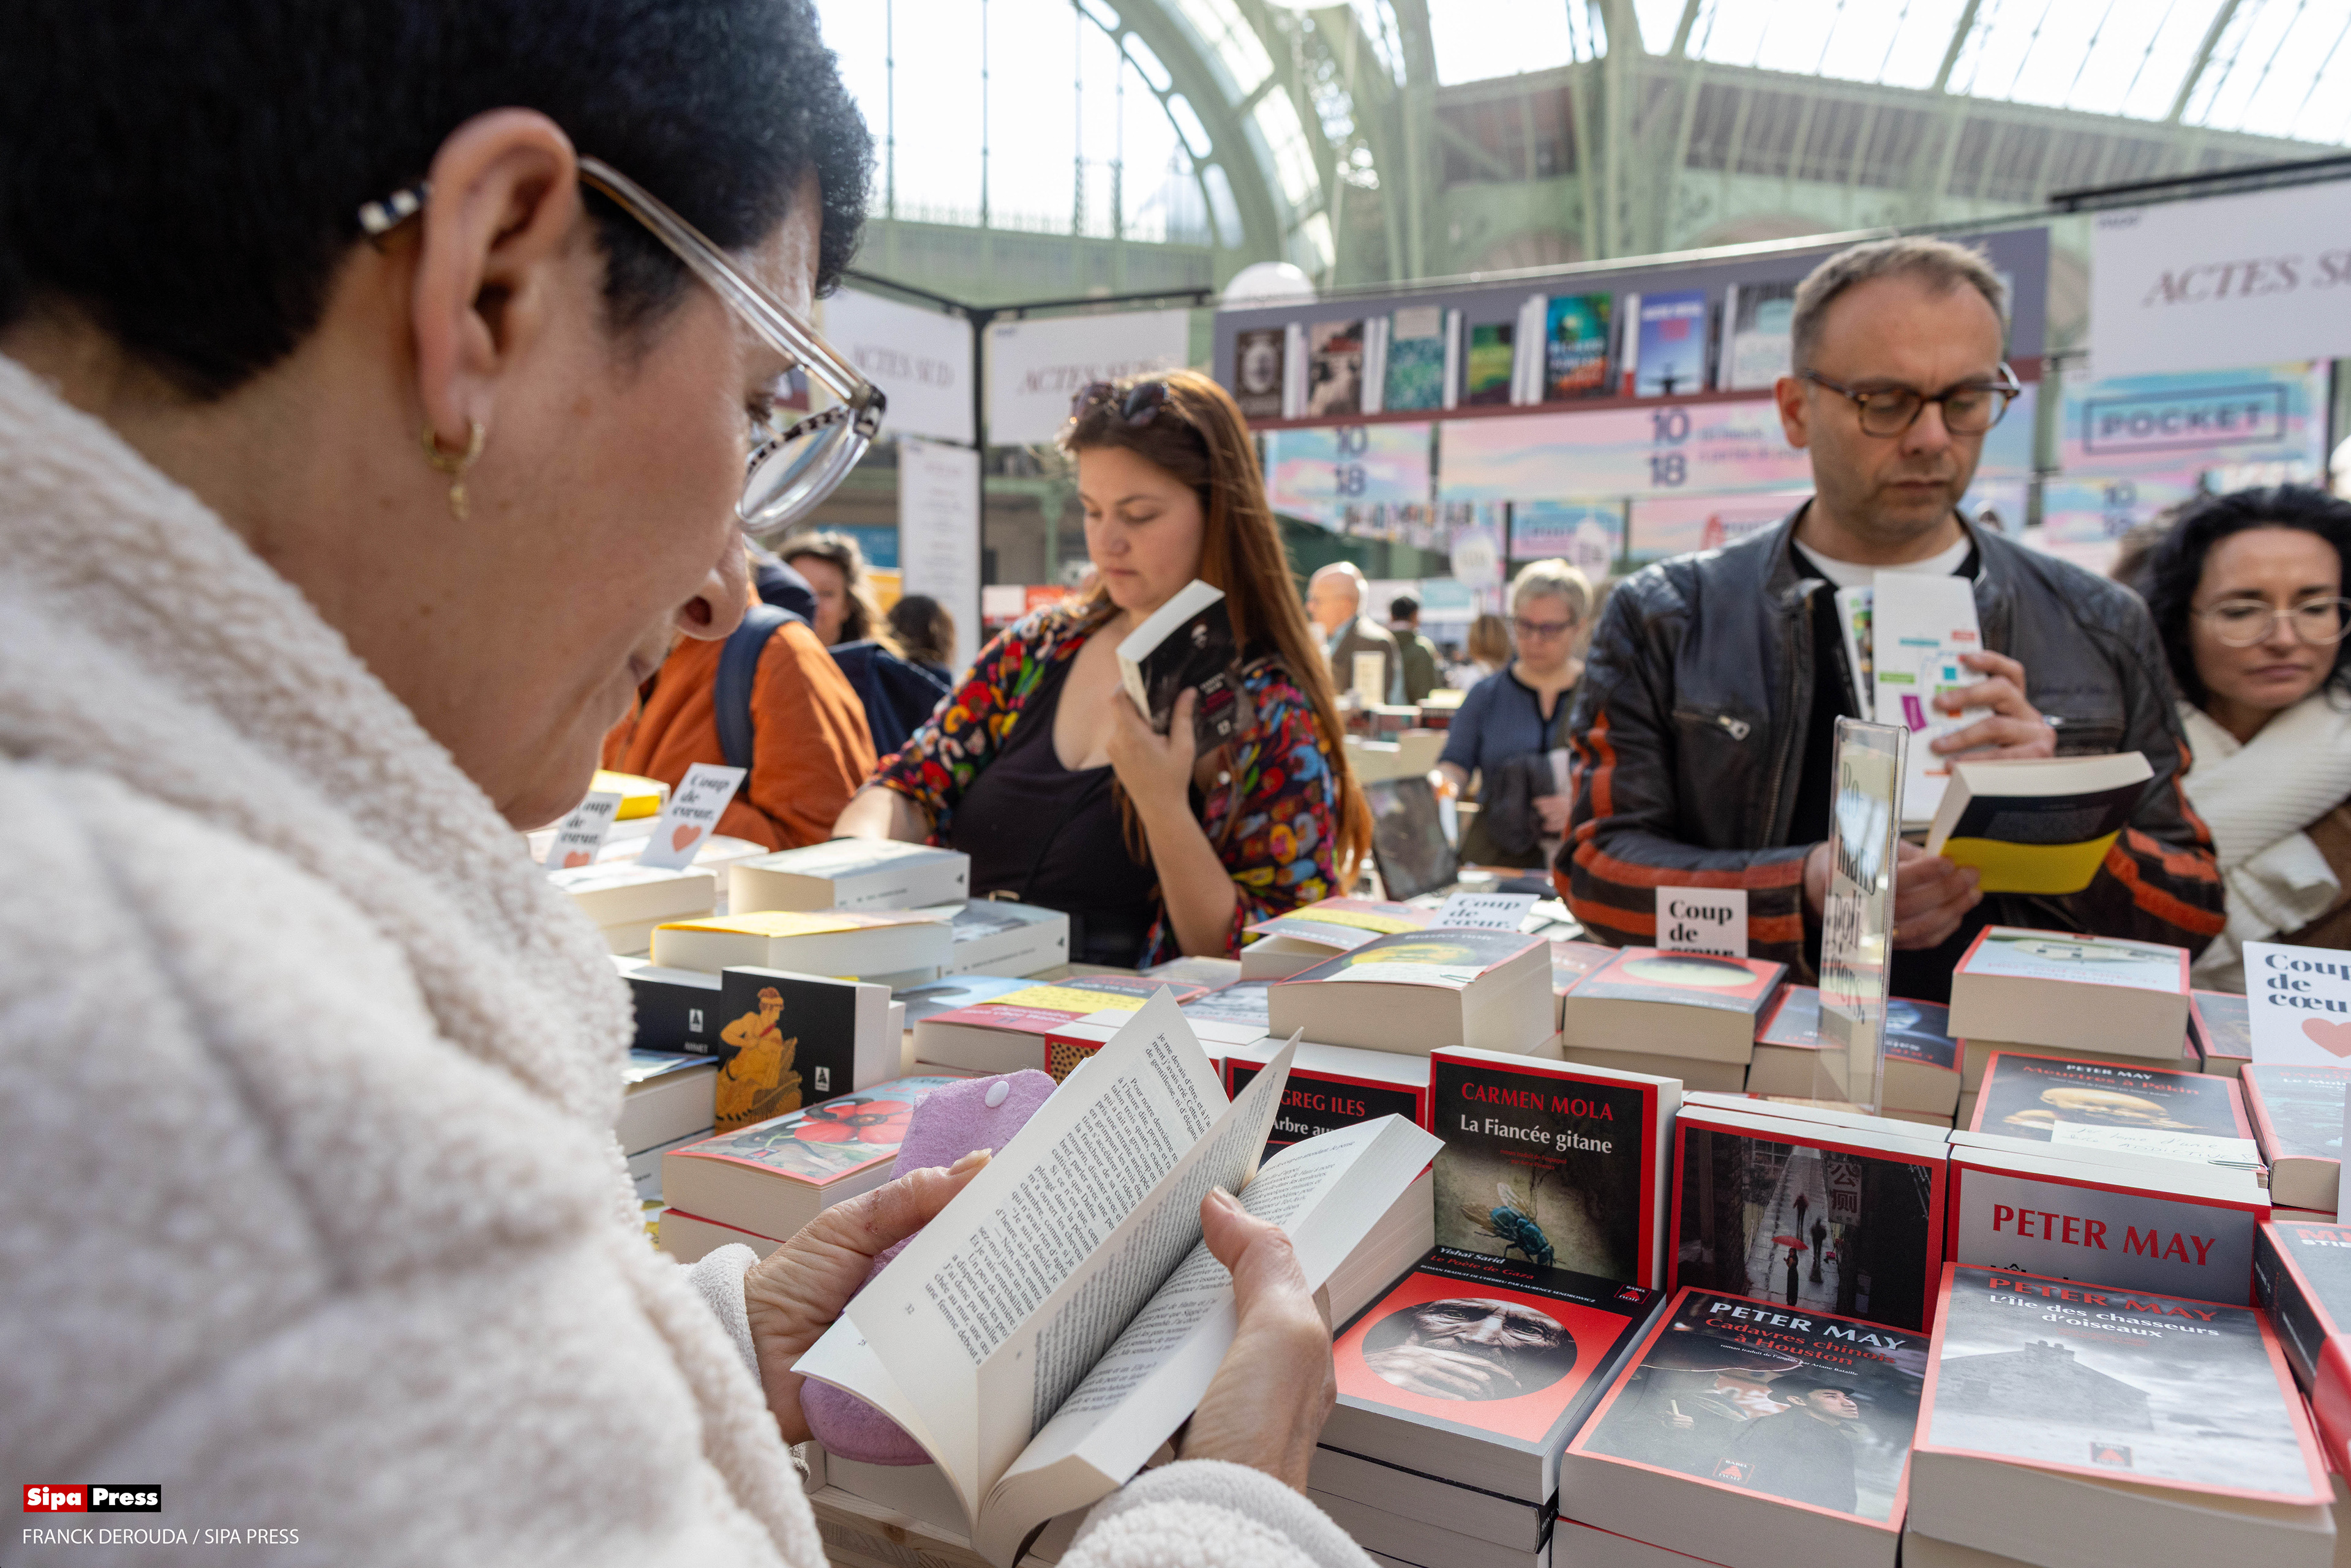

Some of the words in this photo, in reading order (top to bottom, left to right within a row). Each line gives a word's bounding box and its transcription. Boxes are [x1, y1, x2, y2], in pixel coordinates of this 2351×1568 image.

[2142, 255, 2304, 307] ACTES
[1649, 407, 1690, 446] 10
[2101, 402, 2262, 440] POCKET
[1335, 426, 1369, 458] 10
[1334, 464, 1367, 497] 18
[1649, 451, 1687, 488] 18
[578, 801, 612, 817] oup
[680, 789, 700, 803] de
[1449, 908, 1479, 917] de
[1458, 898, 1521, 910] Coup
[1670, 899, 1733, 926] Coup
[1670, 923, 1698, 943] de
[2267, 973, 2312, 992] de
[1145, 1045, 1155, 1059] de
[1150, 1056, 1179, 1101] gentillesse,
[1174, 1096, 1183, 1108] ni
[1152, 1039, 1167, 1060] ment
[1161, 1057, 1181, 1086] j'avais
[1177, 1081, 1190, 1101] crié.
[1185, 1097, 1200, 1120] Cette
[1157, 1031, 1168, 1044] je
[1163, 1041, 1173, 1055] me
[1171, 1051, 1188, 1079] devais
[1183, 1075, 1201, 1104] d'être,
[1196, 1099, 1204, 1111] et
[1201, 1107, 1207, 1116] à
[2023, 1065, 2116, 1084] Meurtres
[2142, 1081, 2200, 1095] Pékin
[2066, 1064, 2113, 1076] PETER
[2117, 1070, 2153, 1080] MAY
[1130, 1076, 1146, 1098] Pour
[1141, 1095, 1156, 1117] notre
[1153, 1114, 1176, 1153] deuxième
[1281, 1089, 1325, 1111] GREG
[1331, 1097, 1366, 1117] ILES
[1461, 1082, 1545, 1111] CARMEN
[1551, 1095, 1614, 1121] MOLA
[1089, 1107, 1097, 1119] en
[1095, 1117, 1120, 1155] grimpant
[1117, 1152, 1128, 1166] les
[1124, 1163, 1138, 1184] trois
[1095, 1098, 1109, 1118] pris
[1106, 1115, 1117, 1131] une
[1114, 1128, 1134, 1158] retraite
[1128, 1154, 1153, 1194] anticipée.
[1101, 1090, 1116, 1108] qui
[1116, 1109, 1128, 1126] fait
[1123, 1125, 1132, 1136] un
[1128, 1135, 1142, 1155] gros
[1138, 1152, 1152, 1175] coup
[1149, 1171, 1157, 1182] en
[1461, 1114, 1479, 1133] La
[1485, 1118, 1551, 1144] Fiancée
[1556, 1130, 1613, 1154] gitane
[1517, 1150, 1534, 1159] traduit
[1542, 1155, 1567, 1165] l'espagnol
[1051, 1146, 1075, 1179] cultivée
[1070, 1178, 1082, 1196] que
[1081, 1192, 1100, 1220] Dafna.
[1057, 1138, 1074, 1161] bref,
[1070, 1157, 1090, 1185] parler
[1086, 1182, 1099, 1202] avec
[1097, 1201, 1108, 1218] une
[1992, 1203, 2109, 1251] PETER
[2123, 1225, 2216, 1266] MAY
[1440, 1247, 1474, 1258] Yishaï
[1474, 1254, 1506, 1265] Sarid
[1447, 1258, 1481, 1269] Poète
[1502, 1269, 1534, 1280] Gaza
[904, 1303, 914, 1315] 32
[1520, 1283, 1552, 1294] LAURENCE
[1552, 1290, 1596, 1303] SENDROWICZ
[1618, 1294, 1640, 1302] noir
[1989, 1277, 2109, 1307] PETER
[2124, 1299, 2218, 1322] MAY
[1709, 1302, 1812, 1332] PETER
[1823, 1326, 1907, 1351] MAY
[2041, 1313, 2164, 1338] d'oiseaux
[2046, 1304, 2088, 1317] des
[2096, 1312, 2221, 1337] chasseurs
[1705, 1319, 1805, 1345] Cadavres
[1813, 1340, 1897, 1365] chinois
[1734, 1334, 1747, 1343] à
[1755, 1338, 1854, 1366] Houston
[1741, 1348, 1763, 1356] traduit
[1772, 1354, 1798, 1364] l'anglais
[1811, 1362, 1834, 1371] Ariane
[1834, 1367, 1859, 1376] Bataille
